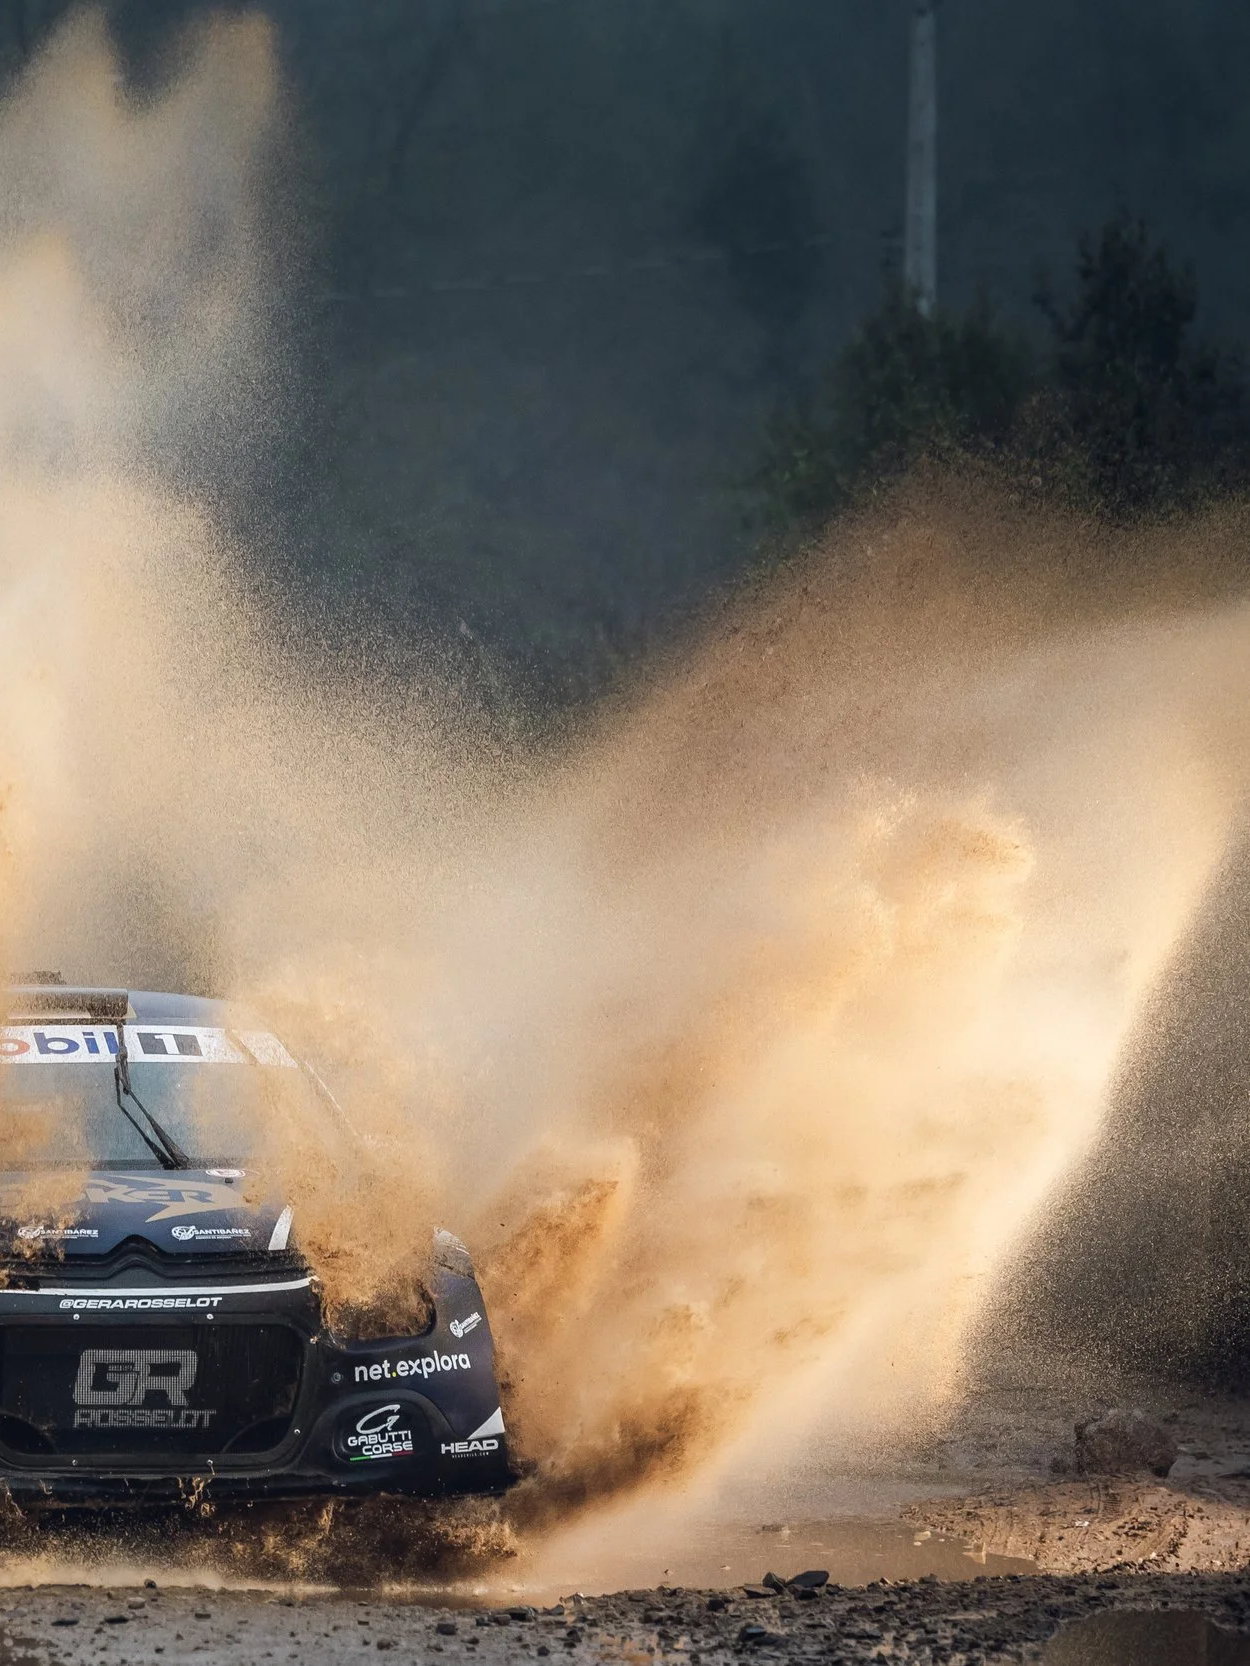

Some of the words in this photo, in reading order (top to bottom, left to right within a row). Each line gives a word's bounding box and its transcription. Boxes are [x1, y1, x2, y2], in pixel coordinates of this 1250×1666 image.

[59, 1297, 222, 1309] @GERAROSSELOT
[354, 1350, 471, 1382] net.explora
[73, 1350, 198, 1405] GR
[73, 1410, 217, 1428] ROSSELOT
[348, 1430, 412, 1447] GABUTTI
[441, 1439, 499, 1454] HEAD
[362, 1440, 414, 1456] CORSE
